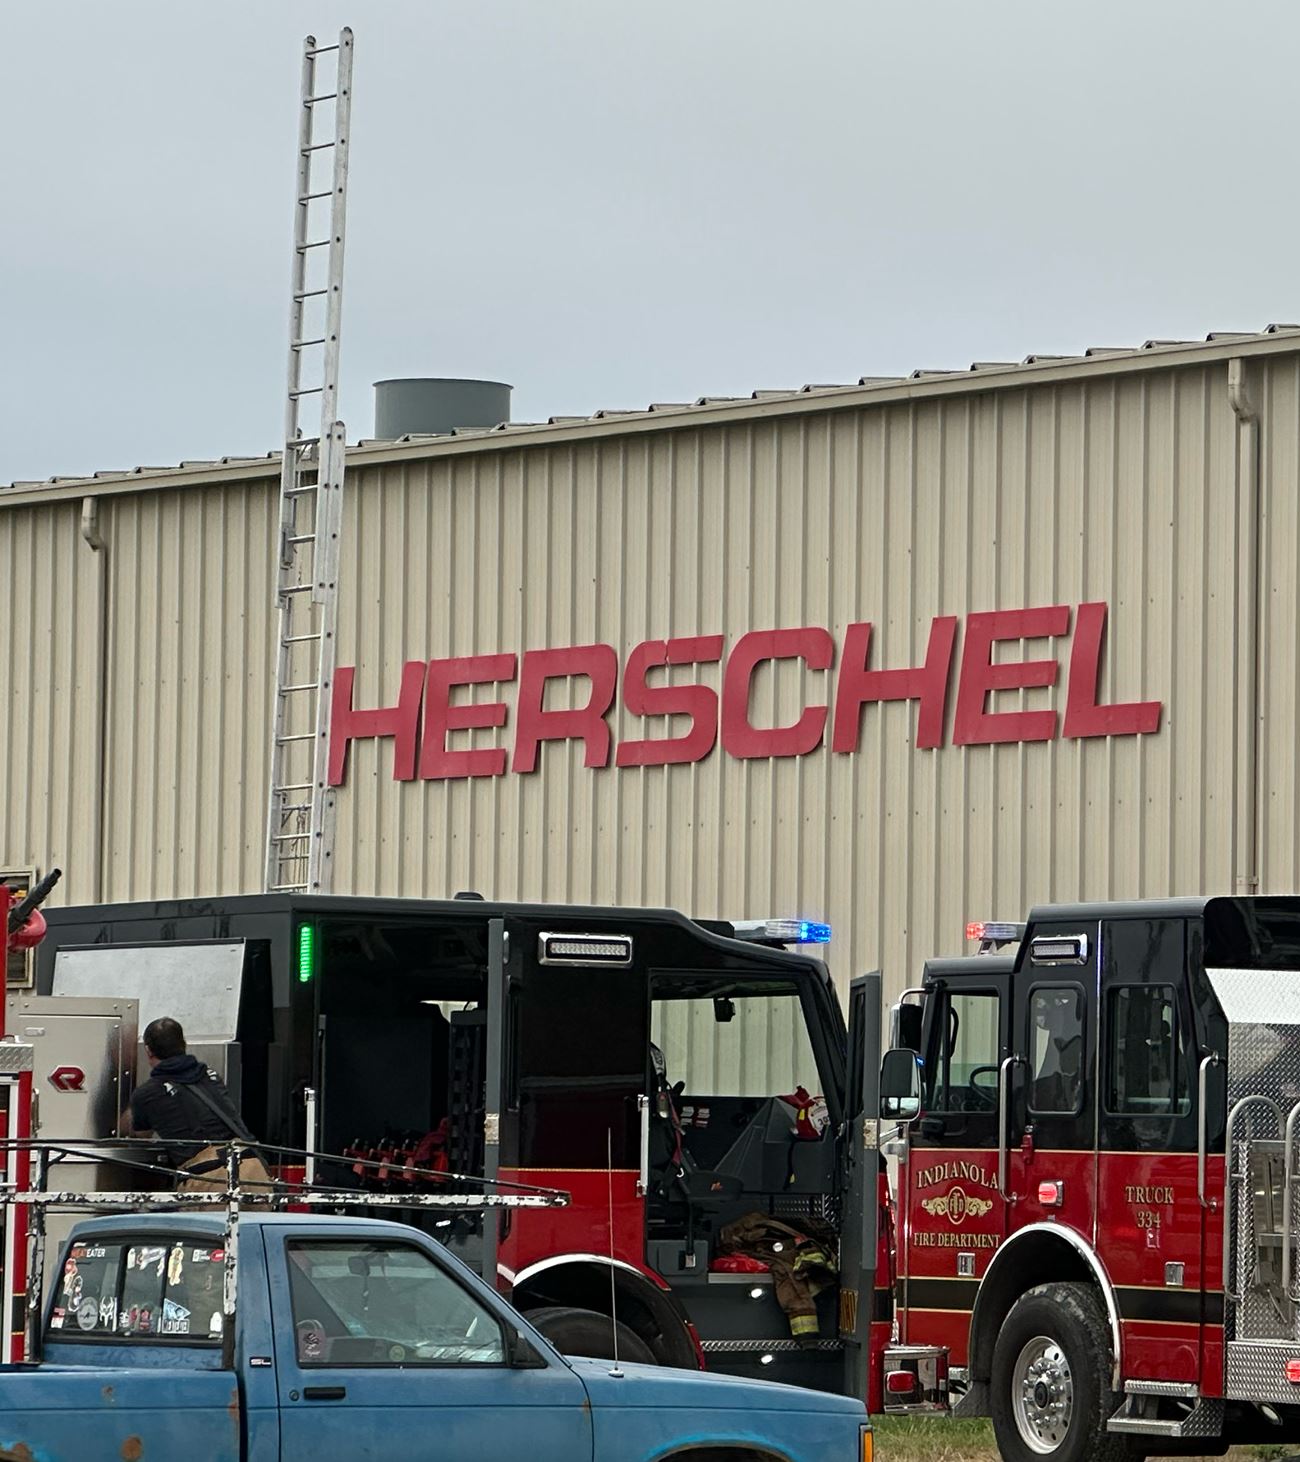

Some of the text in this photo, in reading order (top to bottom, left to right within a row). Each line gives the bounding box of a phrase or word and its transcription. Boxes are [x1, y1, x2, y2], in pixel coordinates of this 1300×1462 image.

[328, 602, 1162, 787] HERSCHEL
[917, 1161, 999, 1189] INDIANOLA
[1125, 1186, 1175, 1204] TRUCK
[1137, 1210, 1161, 1229] 334
[913, 1232, 1001, 1249] FIRE DEPARTMENT
